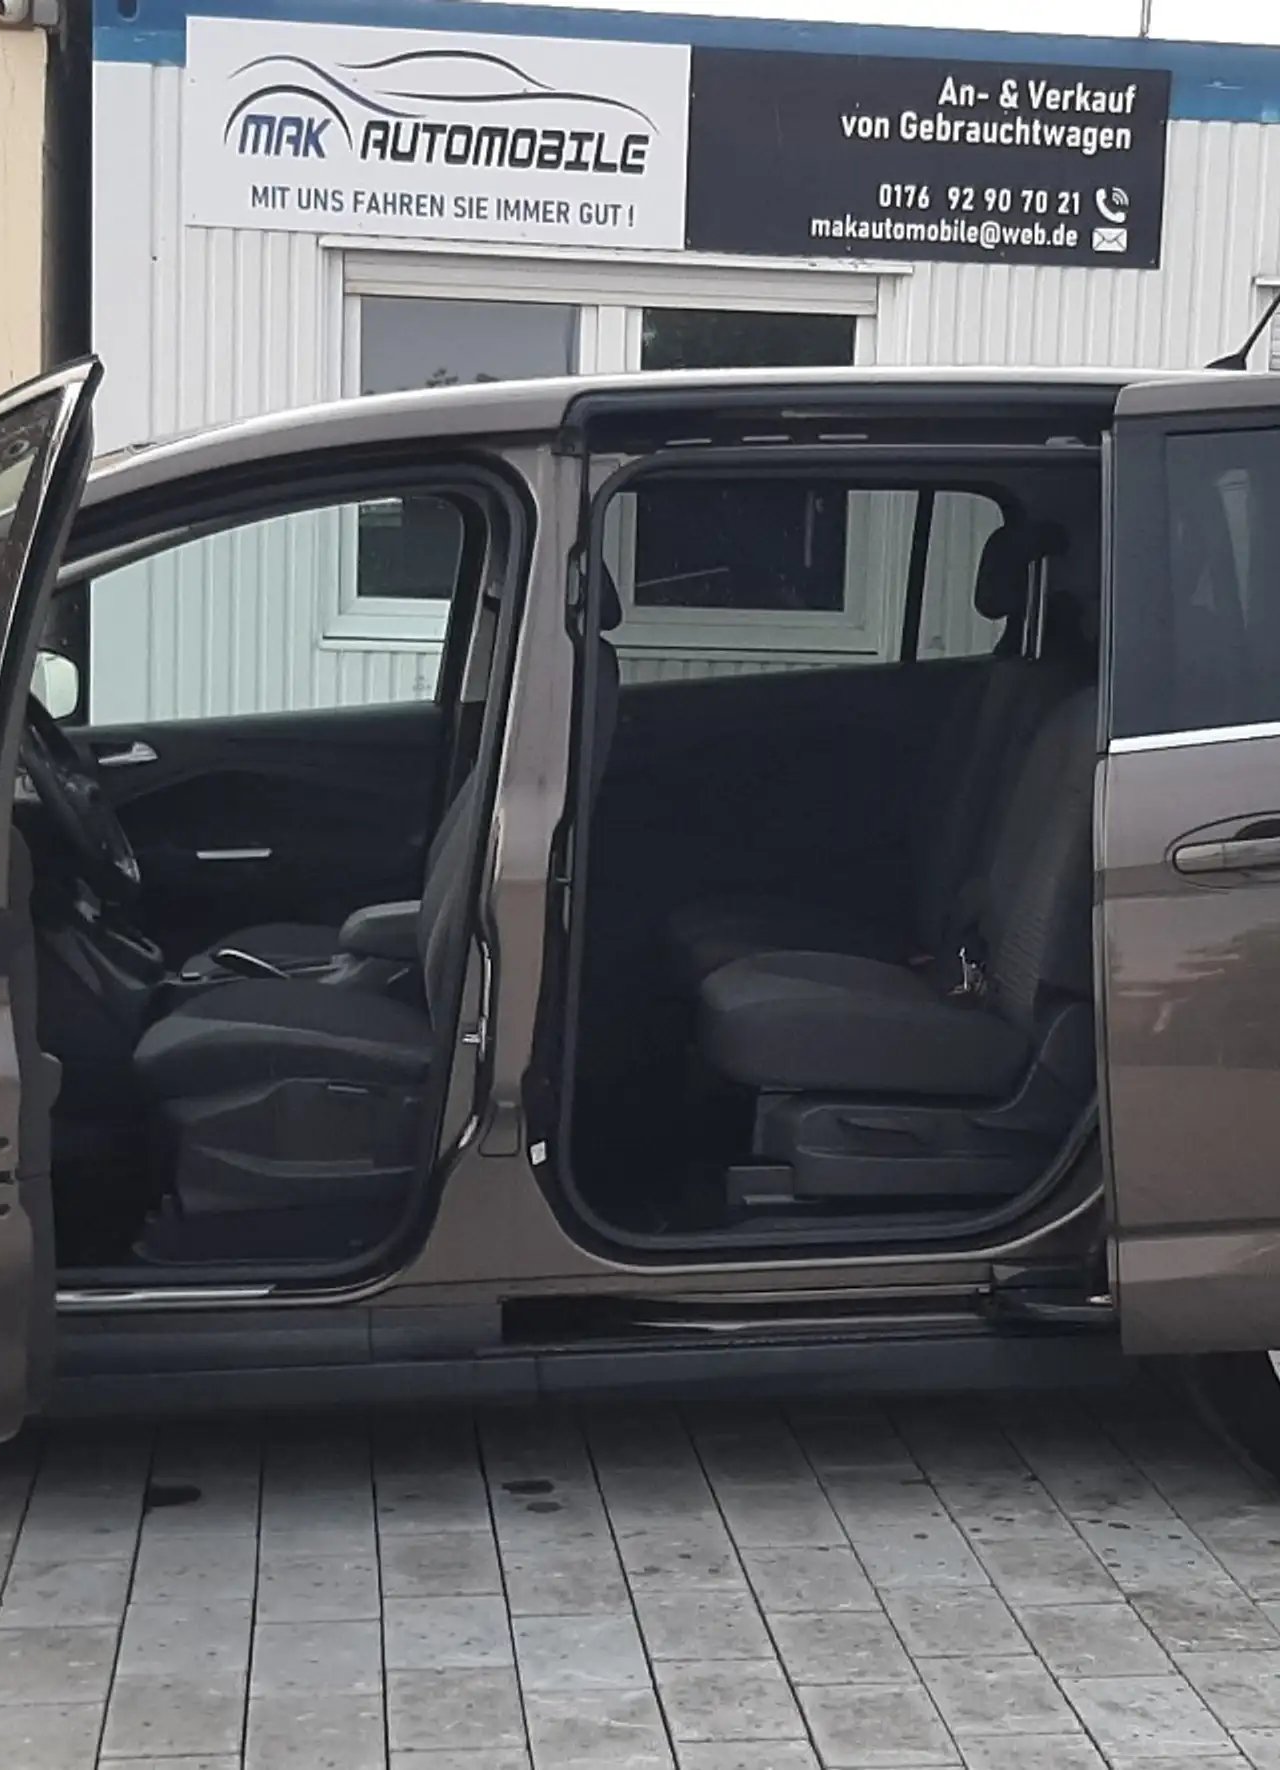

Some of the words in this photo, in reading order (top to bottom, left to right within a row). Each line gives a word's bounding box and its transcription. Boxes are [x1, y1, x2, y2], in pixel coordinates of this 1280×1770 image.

[939, 76, 989, 106] An-
[1000, 79, 1018, 108] &
[1029, 80, 1136, 113] Verkauf
[238, 113, 332, 158] MAK
[360, 119, 650, 175] AUTOMOBILE
[842, 115, 889, 138] von
[901, 111, 1131, 155] Gebrauchtwagen
[251, 184, 291, 209] MIT
[297, 187, 344, 213] UNS
[353, 190, 445, 218] FAHREN
[453, 196, 489, 220] SIE
[496, 198, 570, 225] IMMER
[579, 202, 623, 227] GUT
[880, 184, 930, 209] 0176
[948, 187, 974, 210] 92
[985, 188, 1011, 212] 90
[1021, 190, 1048, 213] 70
[1058, 191, 1080, 214] 21
[811, 213, 1078, 249] makautomobile@web.de
